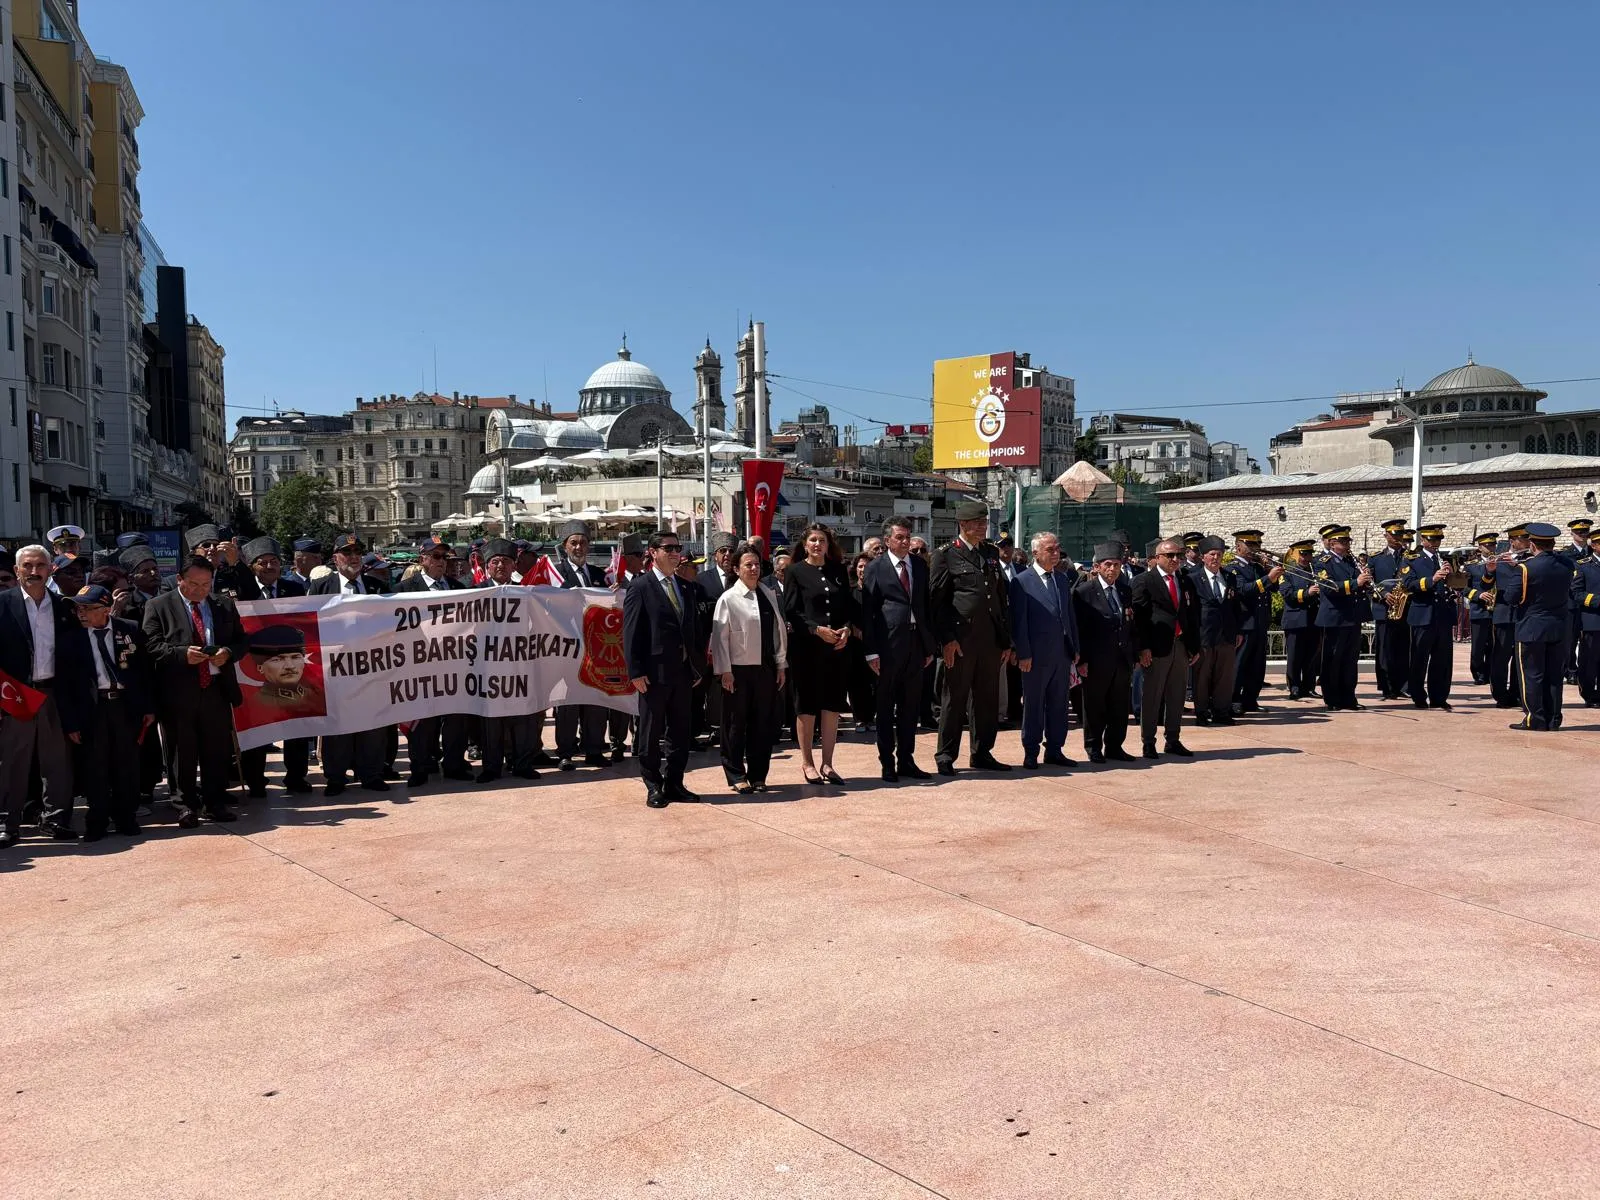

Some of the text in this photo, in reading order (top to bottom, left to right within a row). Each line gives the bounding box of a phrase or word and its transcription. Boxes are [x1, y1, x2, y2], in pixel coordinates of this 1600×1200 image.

[974, 366, 1007, 379] WE ARE
[954, 446, 1025, 460] THE CHAMPIONS
[394, 598, 521, 632] 20 TEMMUZ
[330, 633, 581, 677] KIBRIS BARIŞ HAREKATI
[389, 672, 529, 705] KUTLU OLSUN
